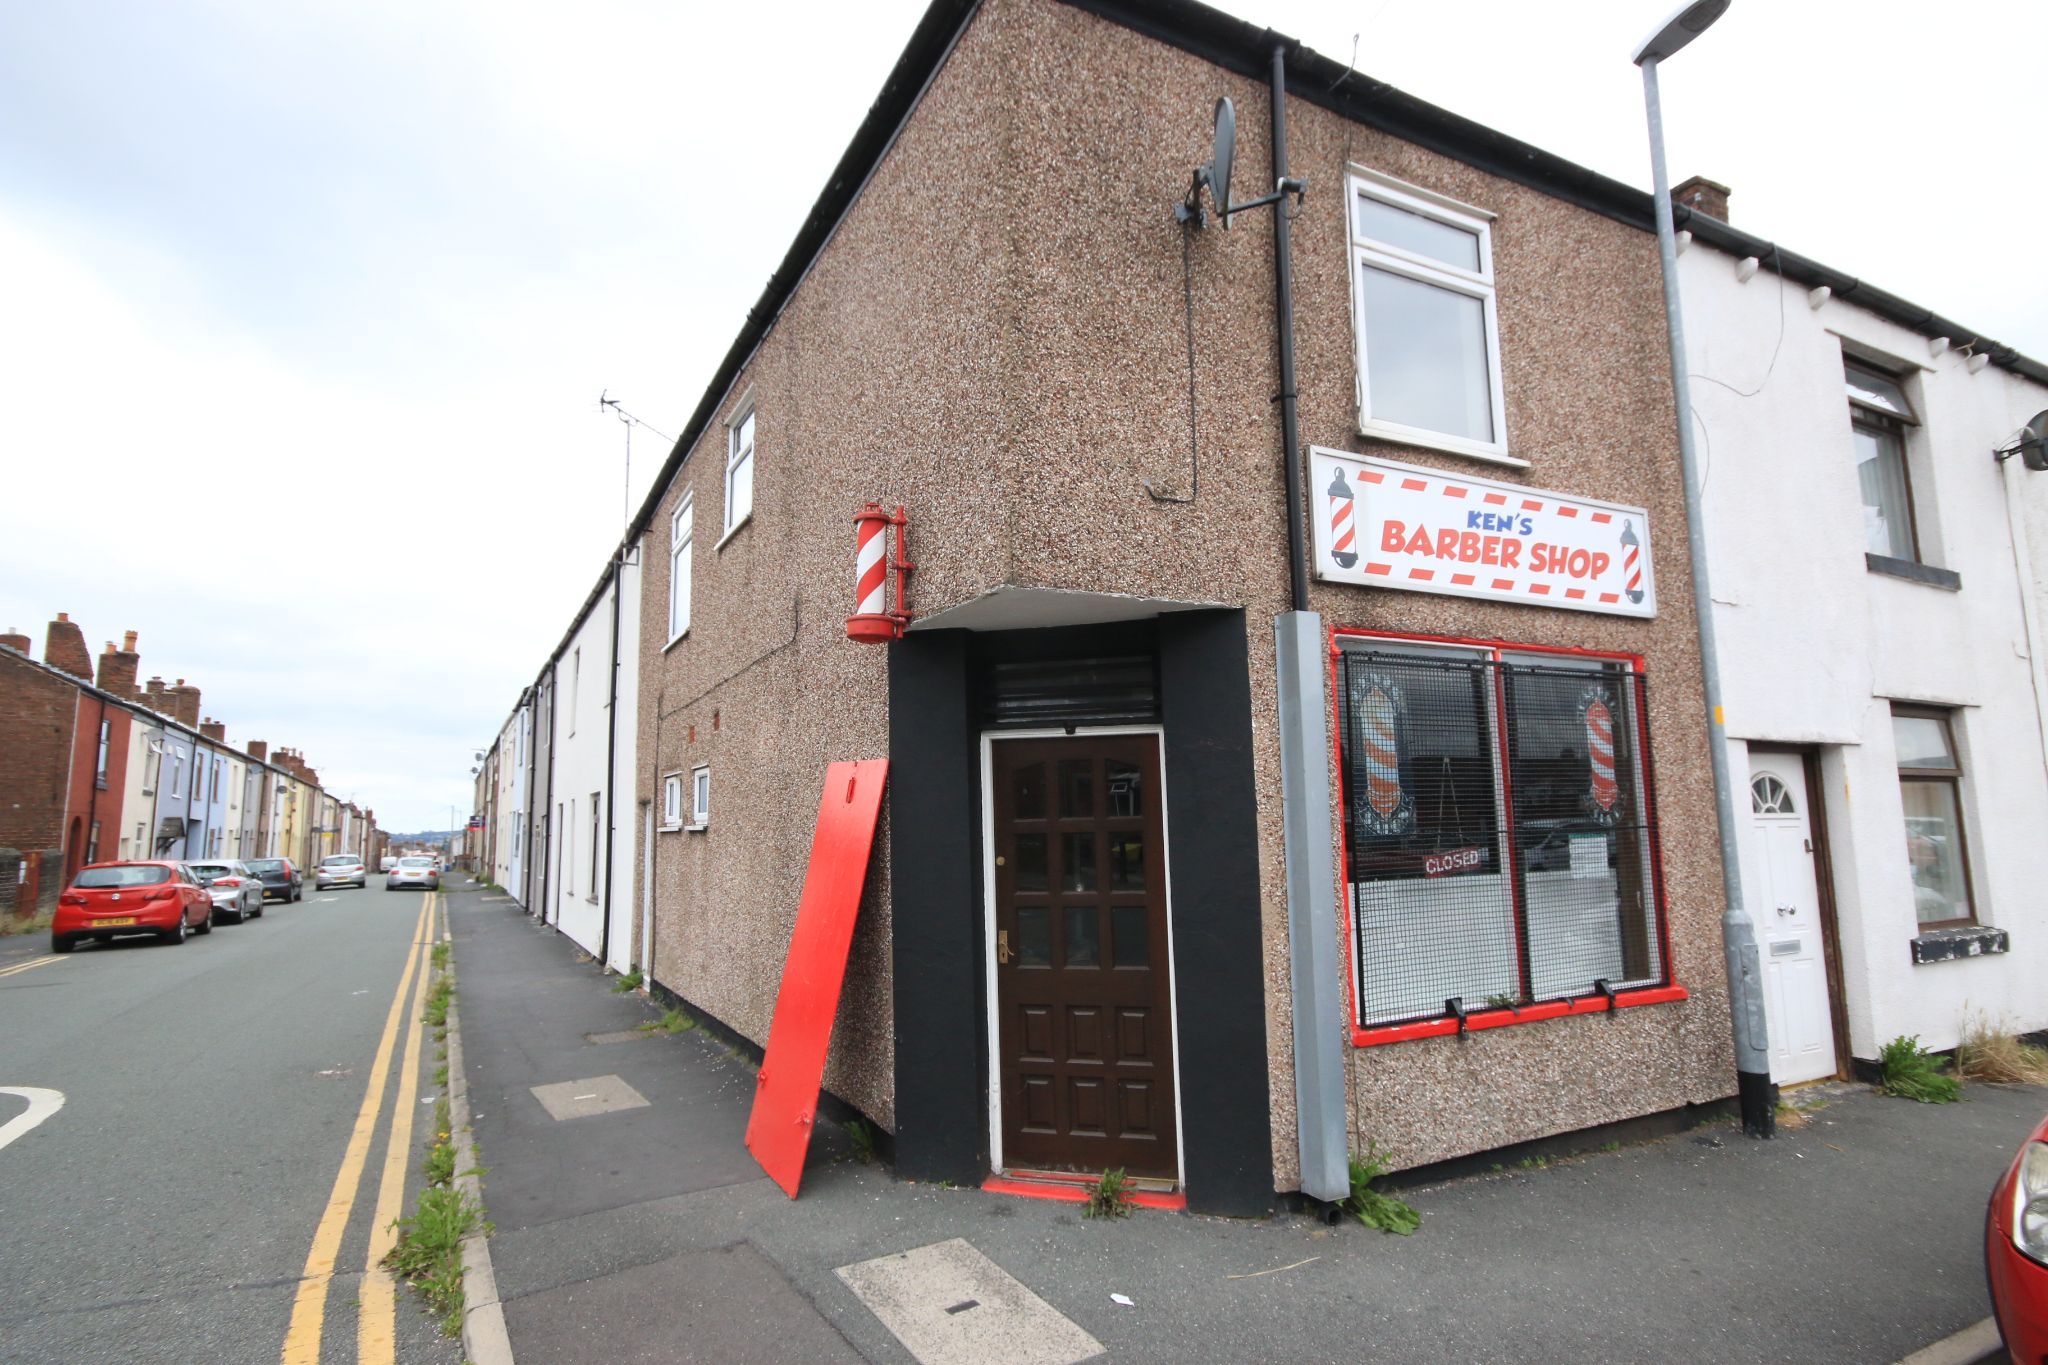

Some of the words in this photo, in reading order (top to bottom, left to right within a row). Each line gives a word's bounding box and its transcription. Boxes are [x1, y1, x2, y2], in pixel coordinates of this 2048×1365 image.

[1467, 510, 1533, 536] KEN'S
[1381, 520, 1522, 569] BARBER
[1529, 542, 1610, 580] SHOP
[1426, 850, 1479, 874] CLOSED
